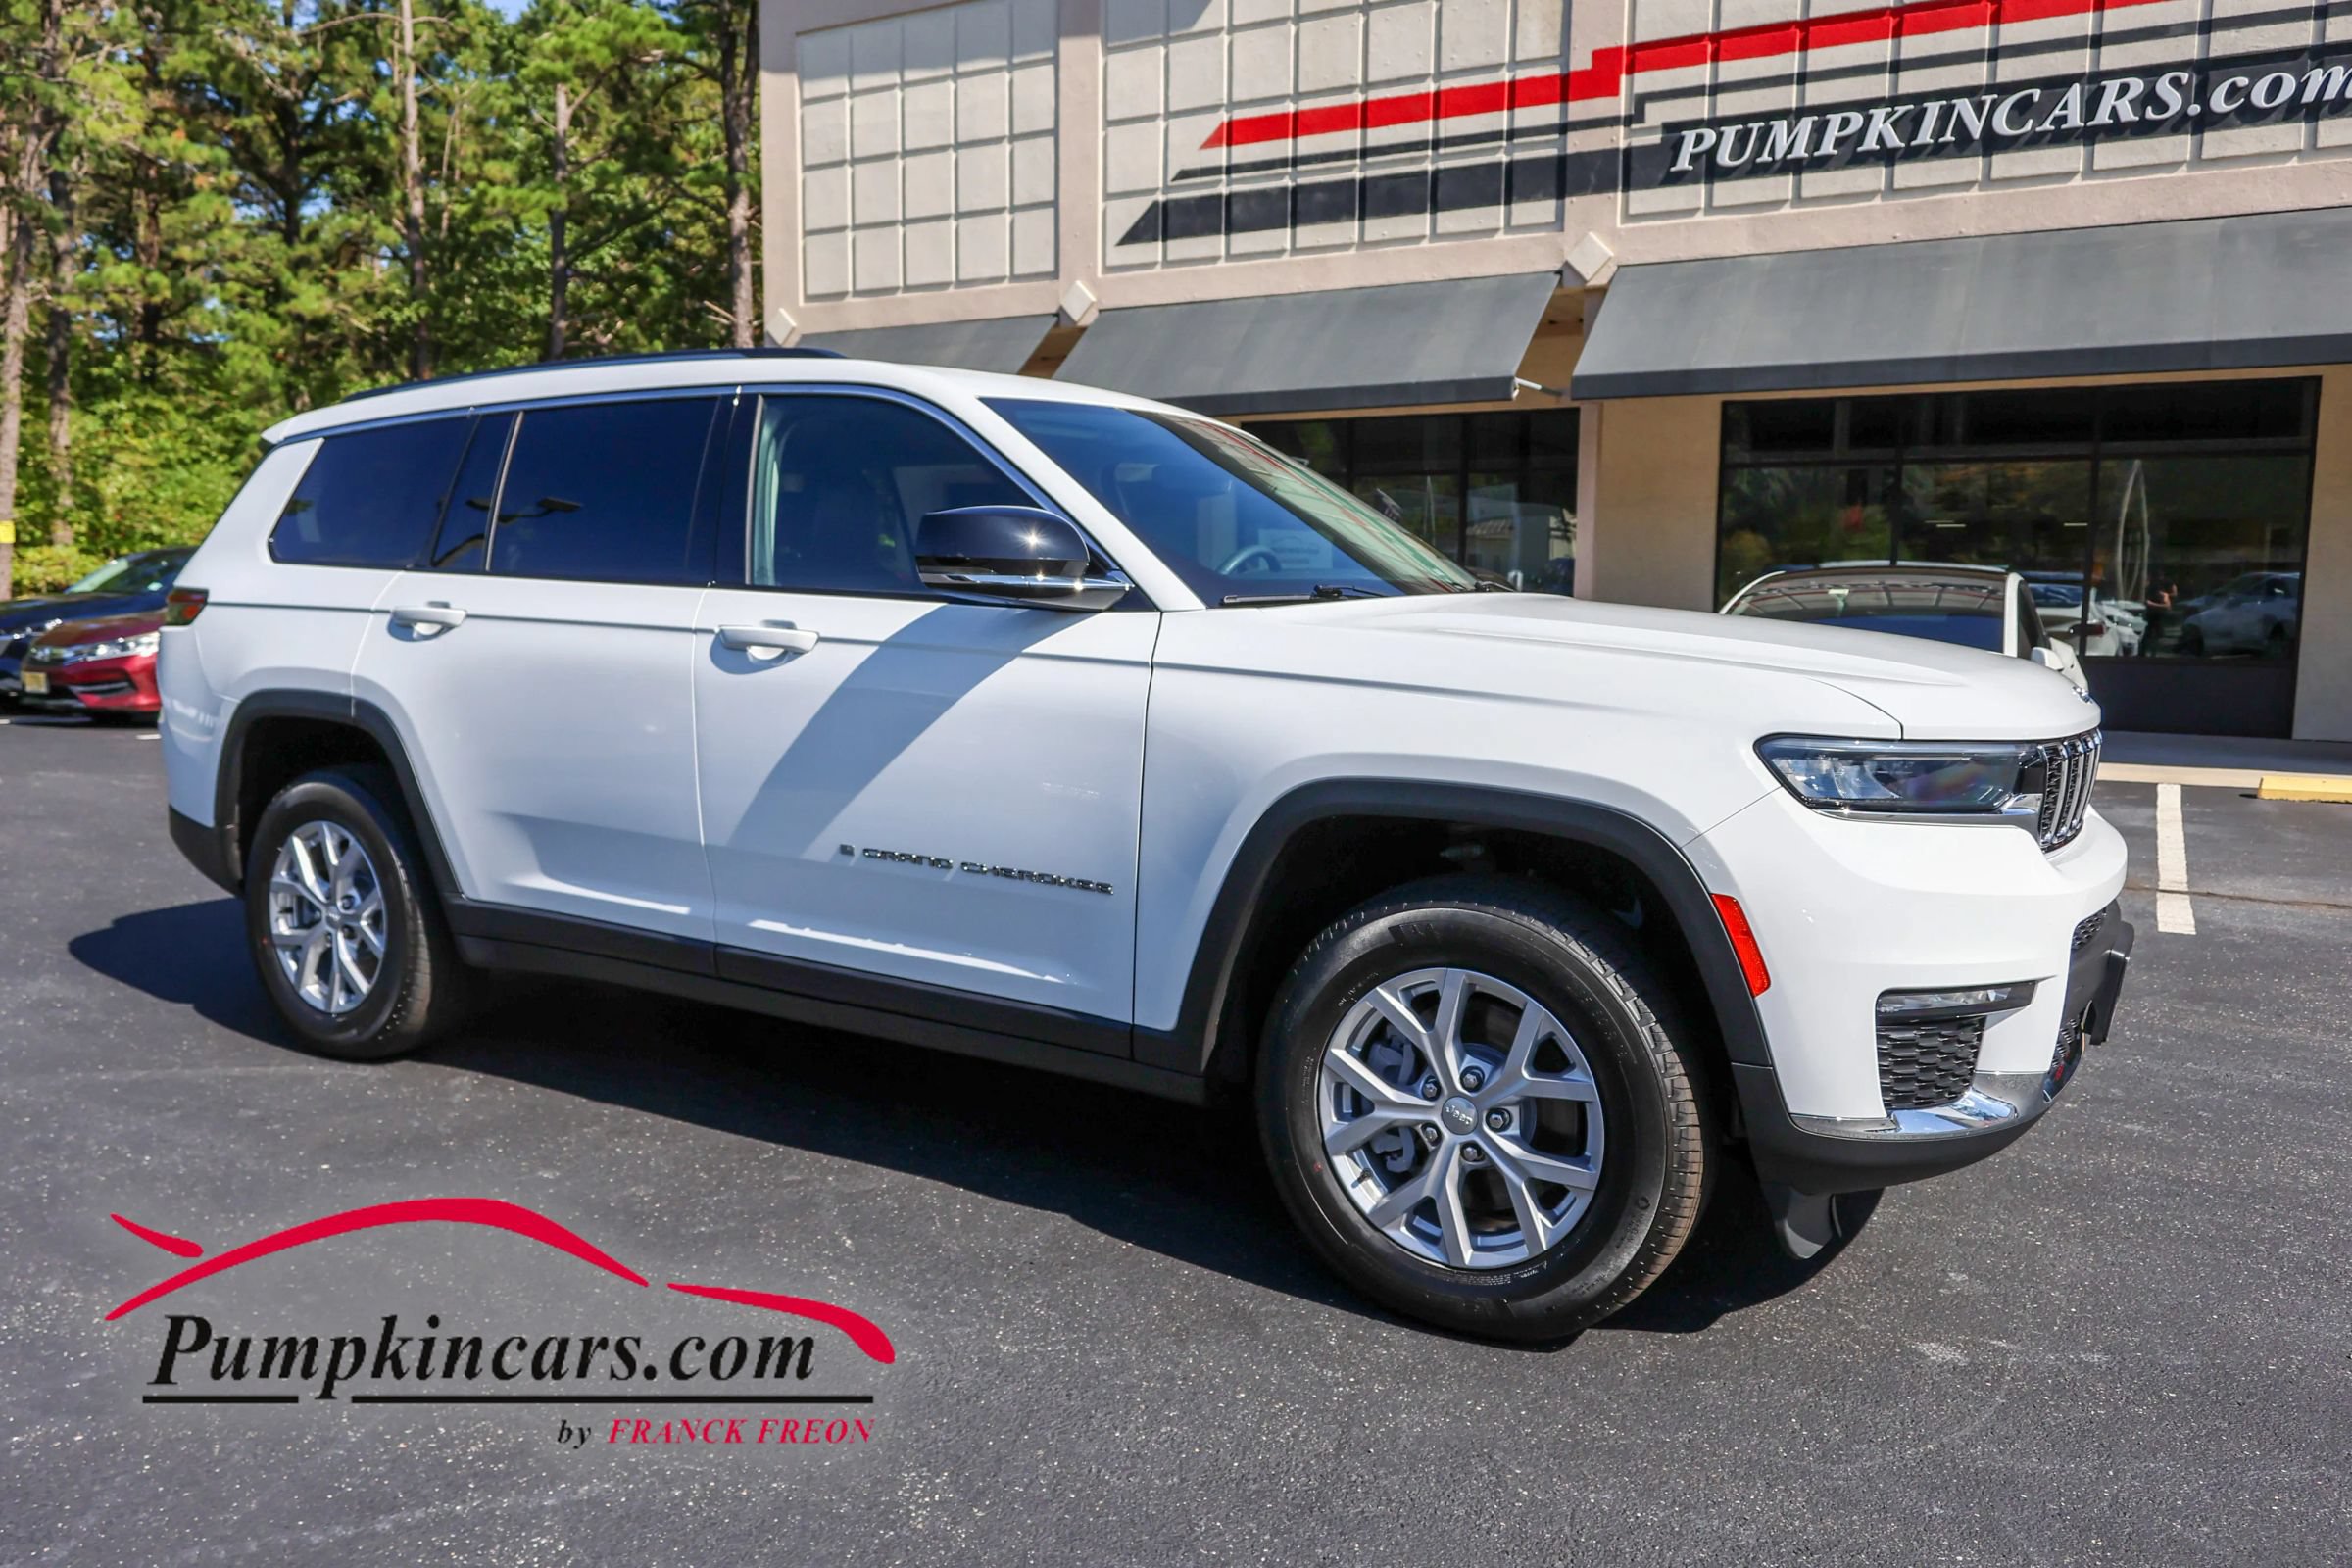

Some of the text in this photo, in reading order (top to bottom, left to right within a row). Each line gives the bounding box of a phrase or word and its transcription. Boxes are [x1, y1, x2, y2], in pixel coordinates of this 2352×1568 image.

[1670, 65, 2352, 172] PUMPKINCARS.com
[863, 848, 1114, 896] GRAND CHEROKEE
